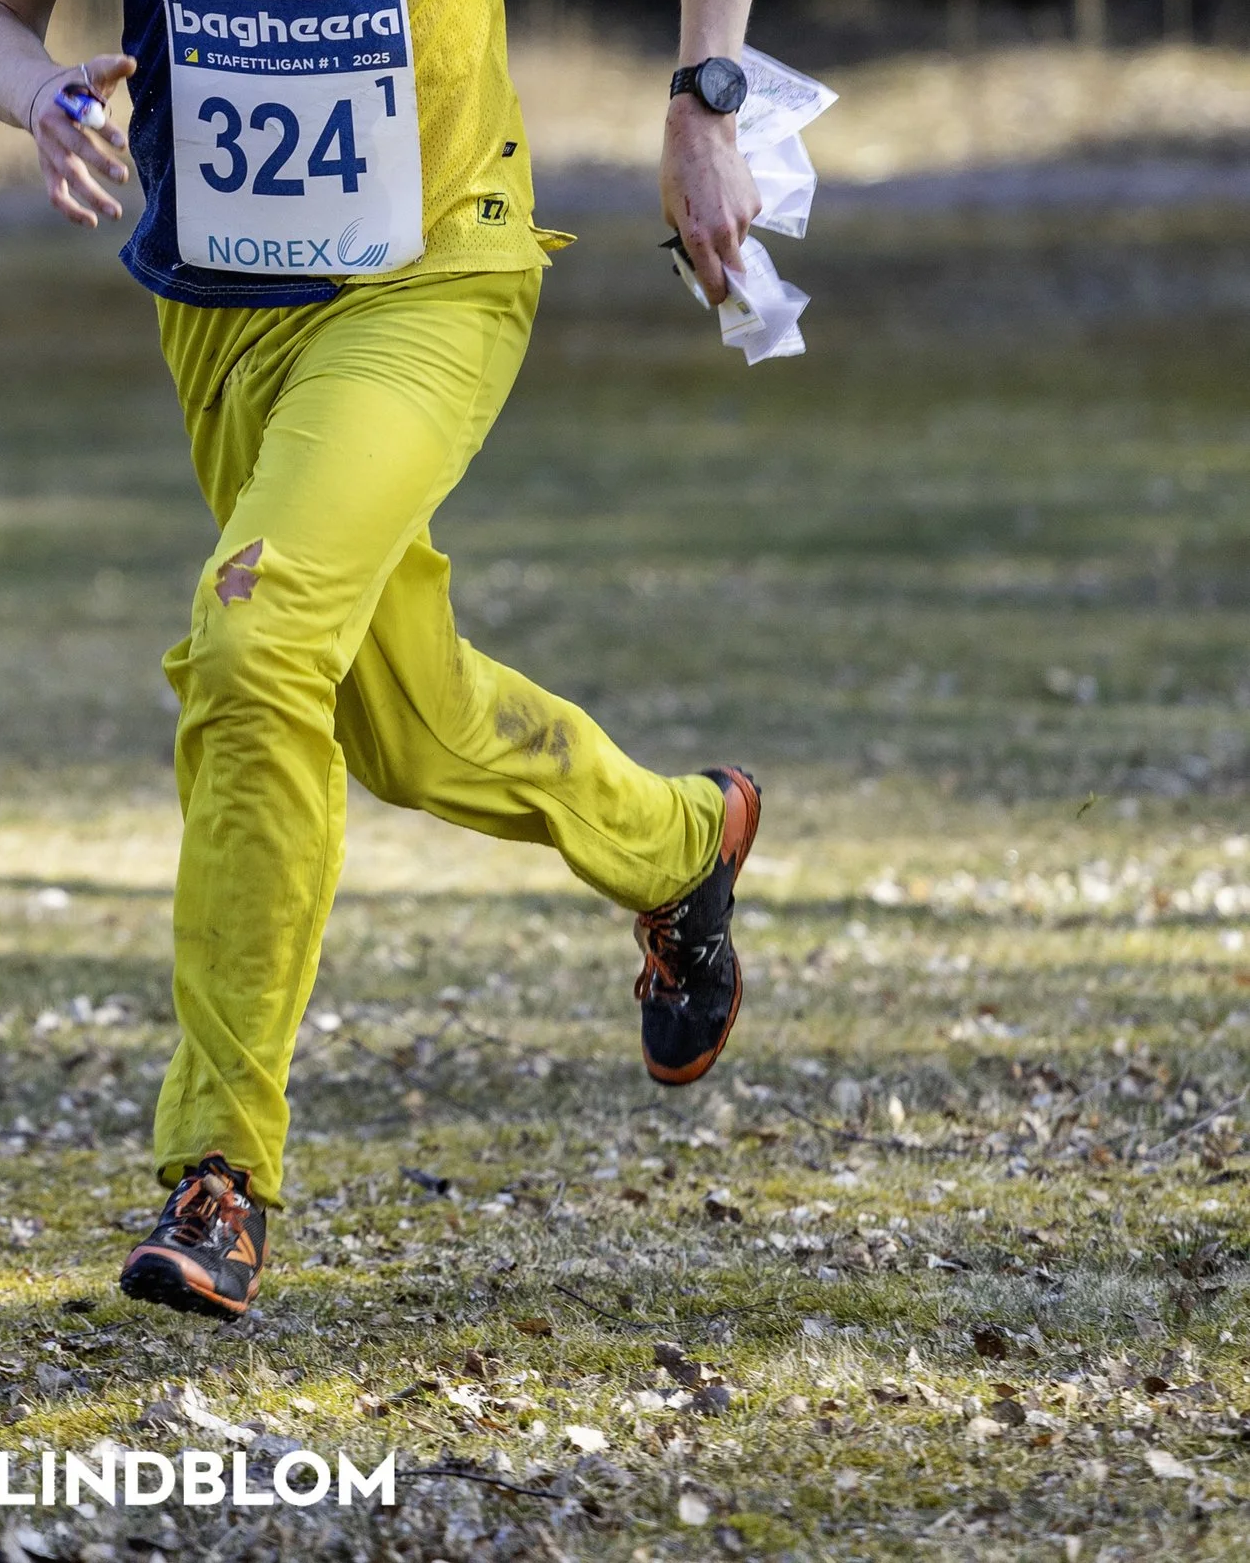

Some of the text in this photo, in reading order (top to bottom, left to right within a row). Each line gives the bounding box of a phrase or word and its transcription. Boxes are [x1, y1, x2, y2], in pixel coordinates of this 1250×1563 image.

[172, 2, 400, 48] bagheera
[207, 52, 314, 70] STAFETTLIGAN
[353, 52, 391, 67] 2025
[375, 75, 397, 118] 1
[198, 96, 367, 196] 324
[208, 235, 332, 268] NOREX
